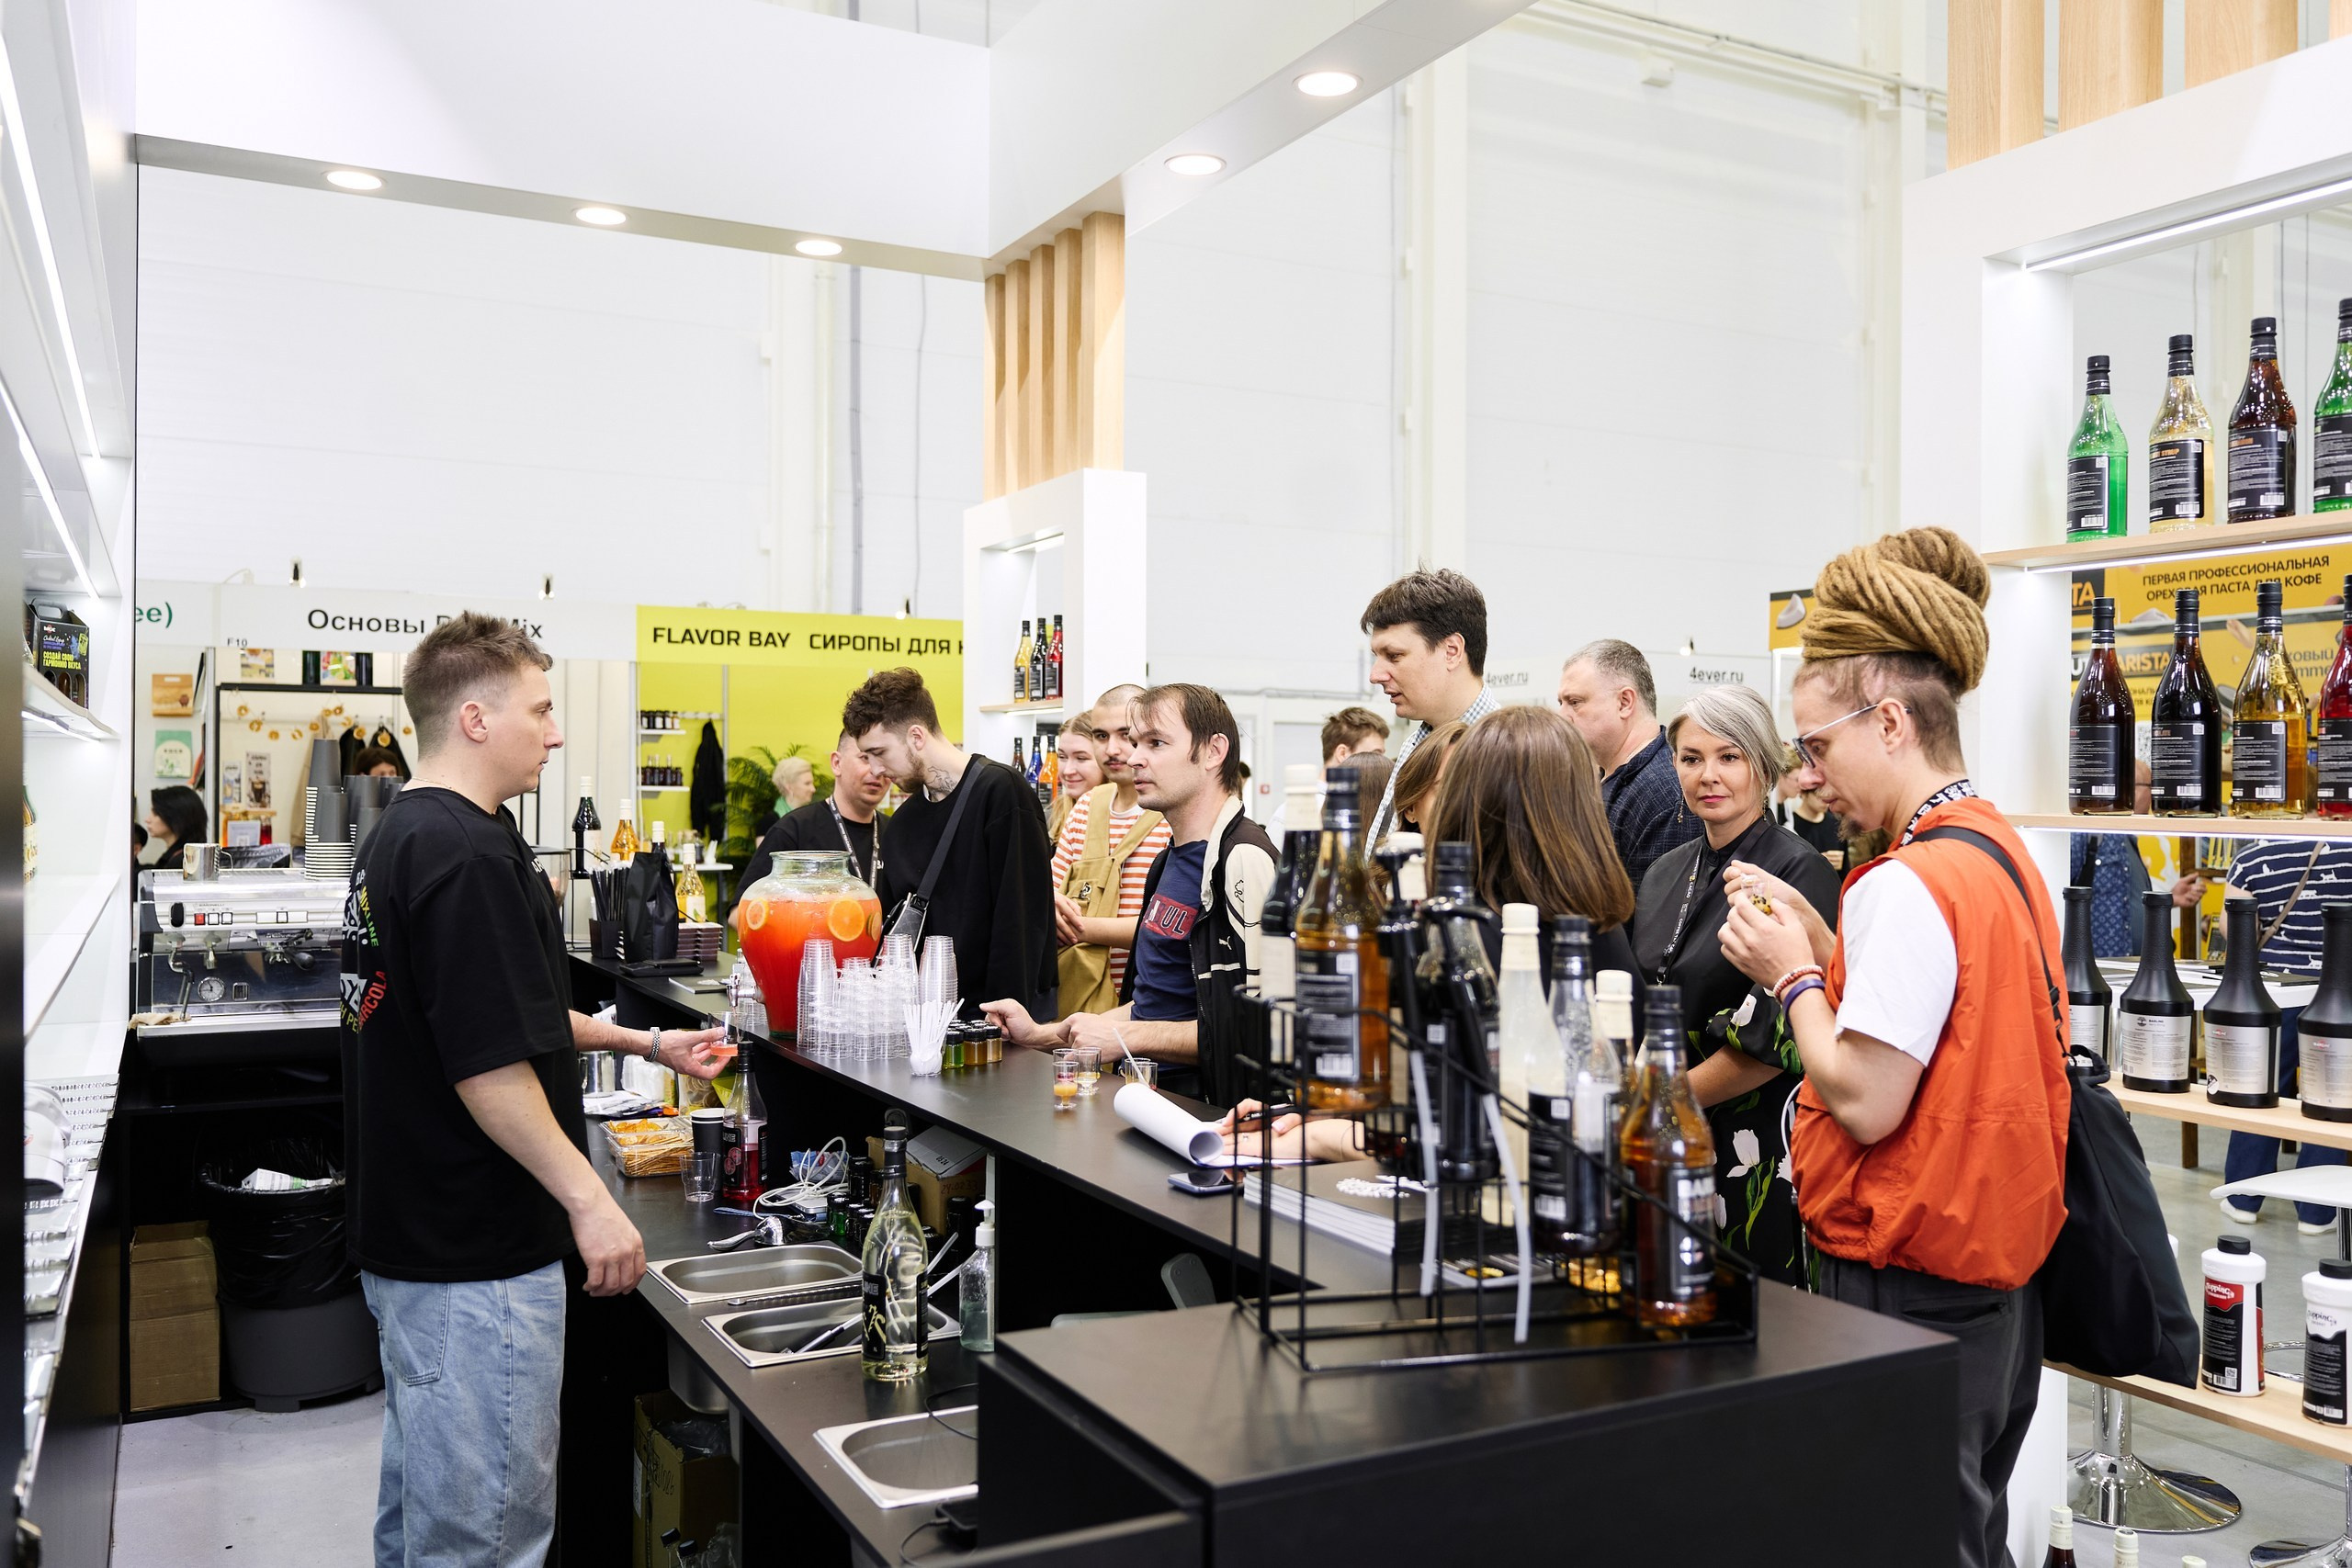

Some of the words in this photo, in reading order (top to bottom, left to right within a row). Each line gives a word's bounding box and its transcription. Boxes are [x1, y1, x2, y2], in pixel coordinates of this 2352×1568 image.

[2143, 571, 2186, 586] ПЕРВАЯ
[2188, 555, 2330, 581] ПРОФЕССИОНАЛЬНАЯ
[2211, 580, 2250, 595] ПАСТА
[2285, 572, 2322, 589] КОФЕ
[308, 609, 425, 634] Основы
[653, 627, 741, 648] FLAVOR
[749, 631, 790, 648] BAY
[809, 634, 900, 651] СИРОПЫ
[908, 637, 950, 656] ДЛЯ
[1690, 667, 1744, 682] 4ever.ru
